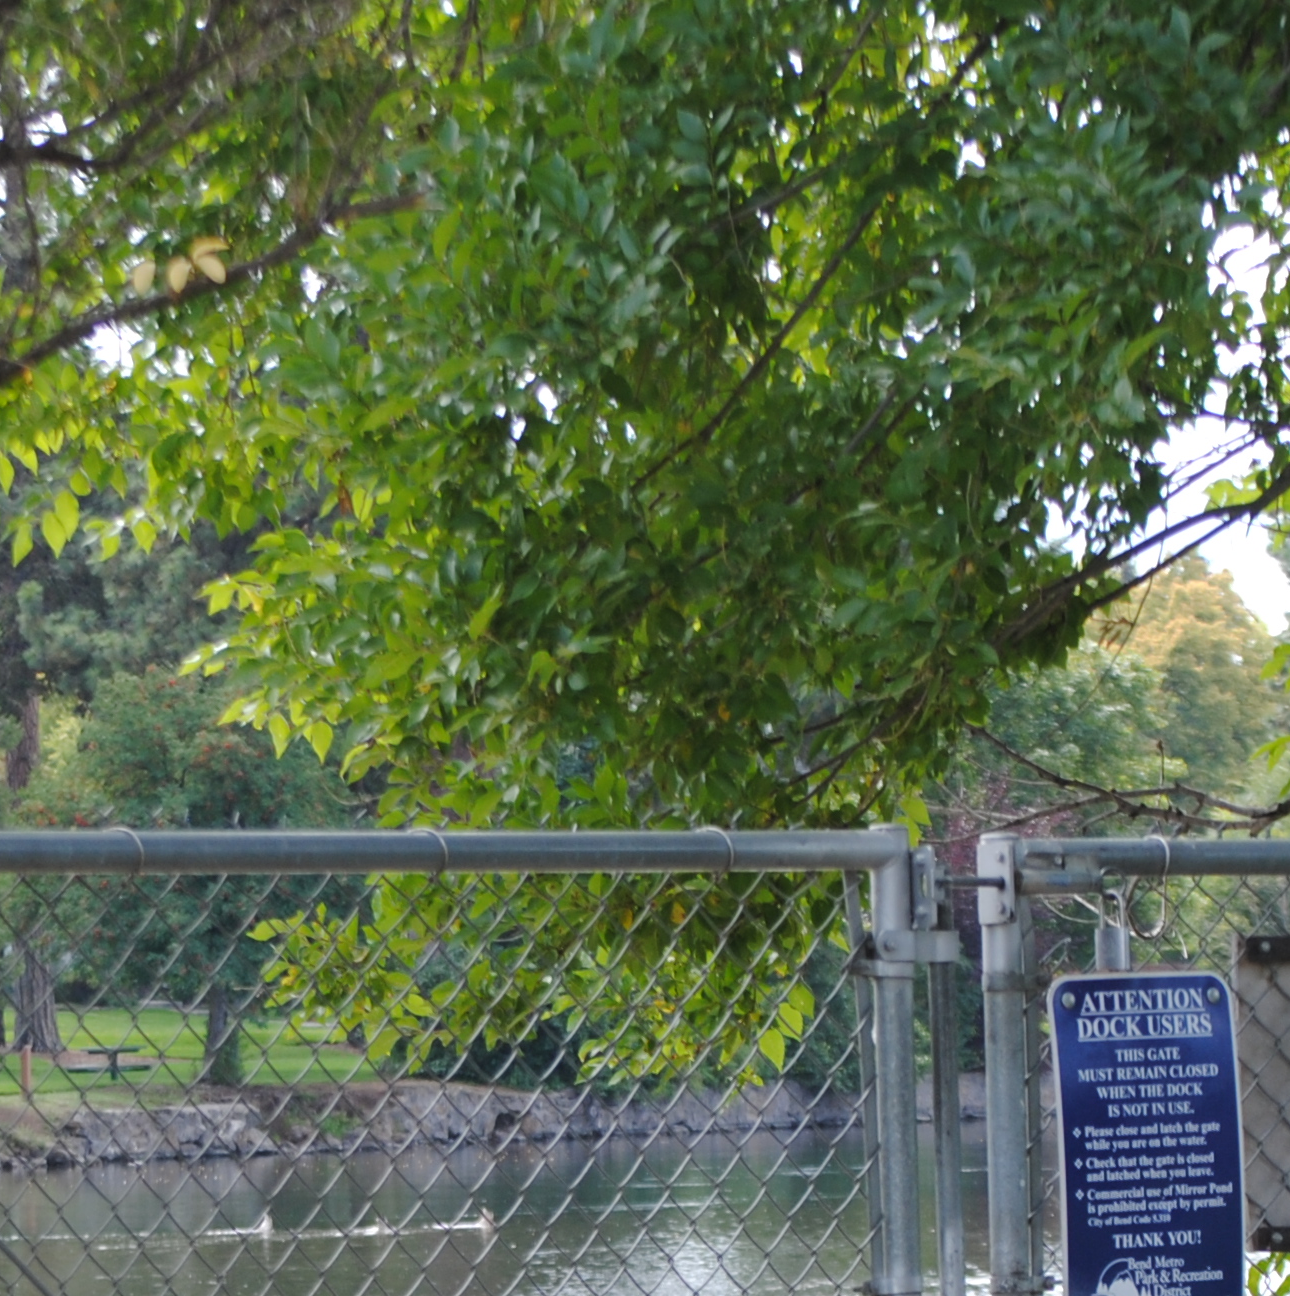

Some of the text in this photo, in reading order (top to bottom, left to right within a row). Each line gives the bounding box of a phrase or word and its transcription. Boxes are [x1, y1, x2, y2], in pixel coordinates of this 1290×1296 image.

[1081, 988, 1203, 1012] ATTENTION
[1077, 1014, 1212, 1039] DOCK USERS
[1115, 1047, 1180, 1062] THIS GATE
[1078, 1064, 1218, 1082] MUST REMAIN CLOSED
[1097, 1082, 1202, 1099] WHEN THE DOCK
[1108, 1101, 1194, 1117] IS NOT IN USE.
[1085, 1121, 1220, 1137] Please close and latch the gate
[1085, 1136, 1207, 1152] while you are on the water.
[1086, 1152, 1214, 1168] Check that the gate is closed
[1087, 1166, 1213, 1182] and latched when you leave.
[1087, 1182, 1232, 1200] Commercial use of Mirror Pond
[1088, 1196, 1226, 1215] is prohibited except by permit.
[1088, 1218, 1103, 1228] City
[1105, 1217, 1112, 1226] of
[1114, 1216, 1132, 1225] Bend
[1113, 1230, 1202, 1249] THANK YOU!
[1128, 1256, 1184, 1269] Bend Metro
[1135, 1266, 1223, 1284] Park & Recreation
